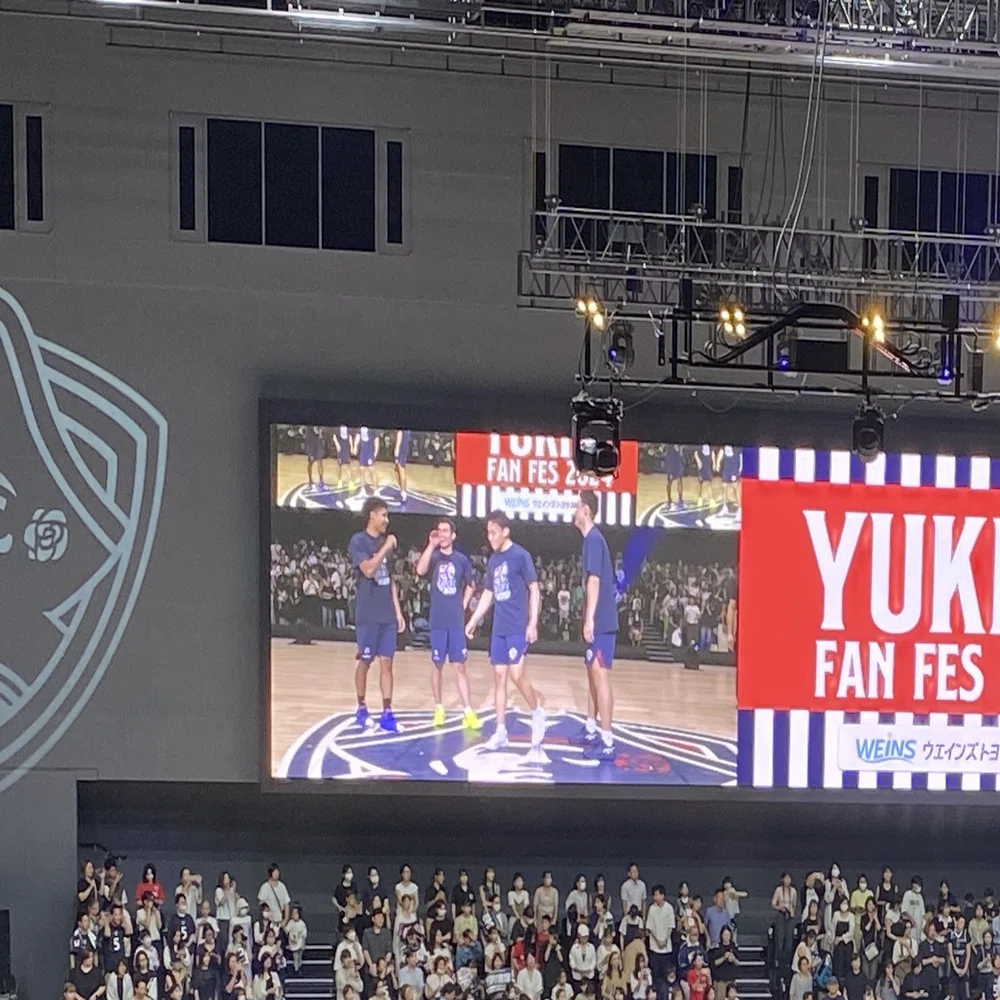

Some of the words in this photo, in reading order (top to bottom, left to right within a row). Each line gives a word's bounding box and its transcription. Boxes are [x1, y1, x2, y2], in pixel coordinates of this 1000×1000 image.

[487, 458, 521, 483] FAN
[528, 459, 558, 485] FES
[813, 640, 896, 699] FAN
[913, 642, 985, 702] FES
[113, 938, 121, 951] 5
